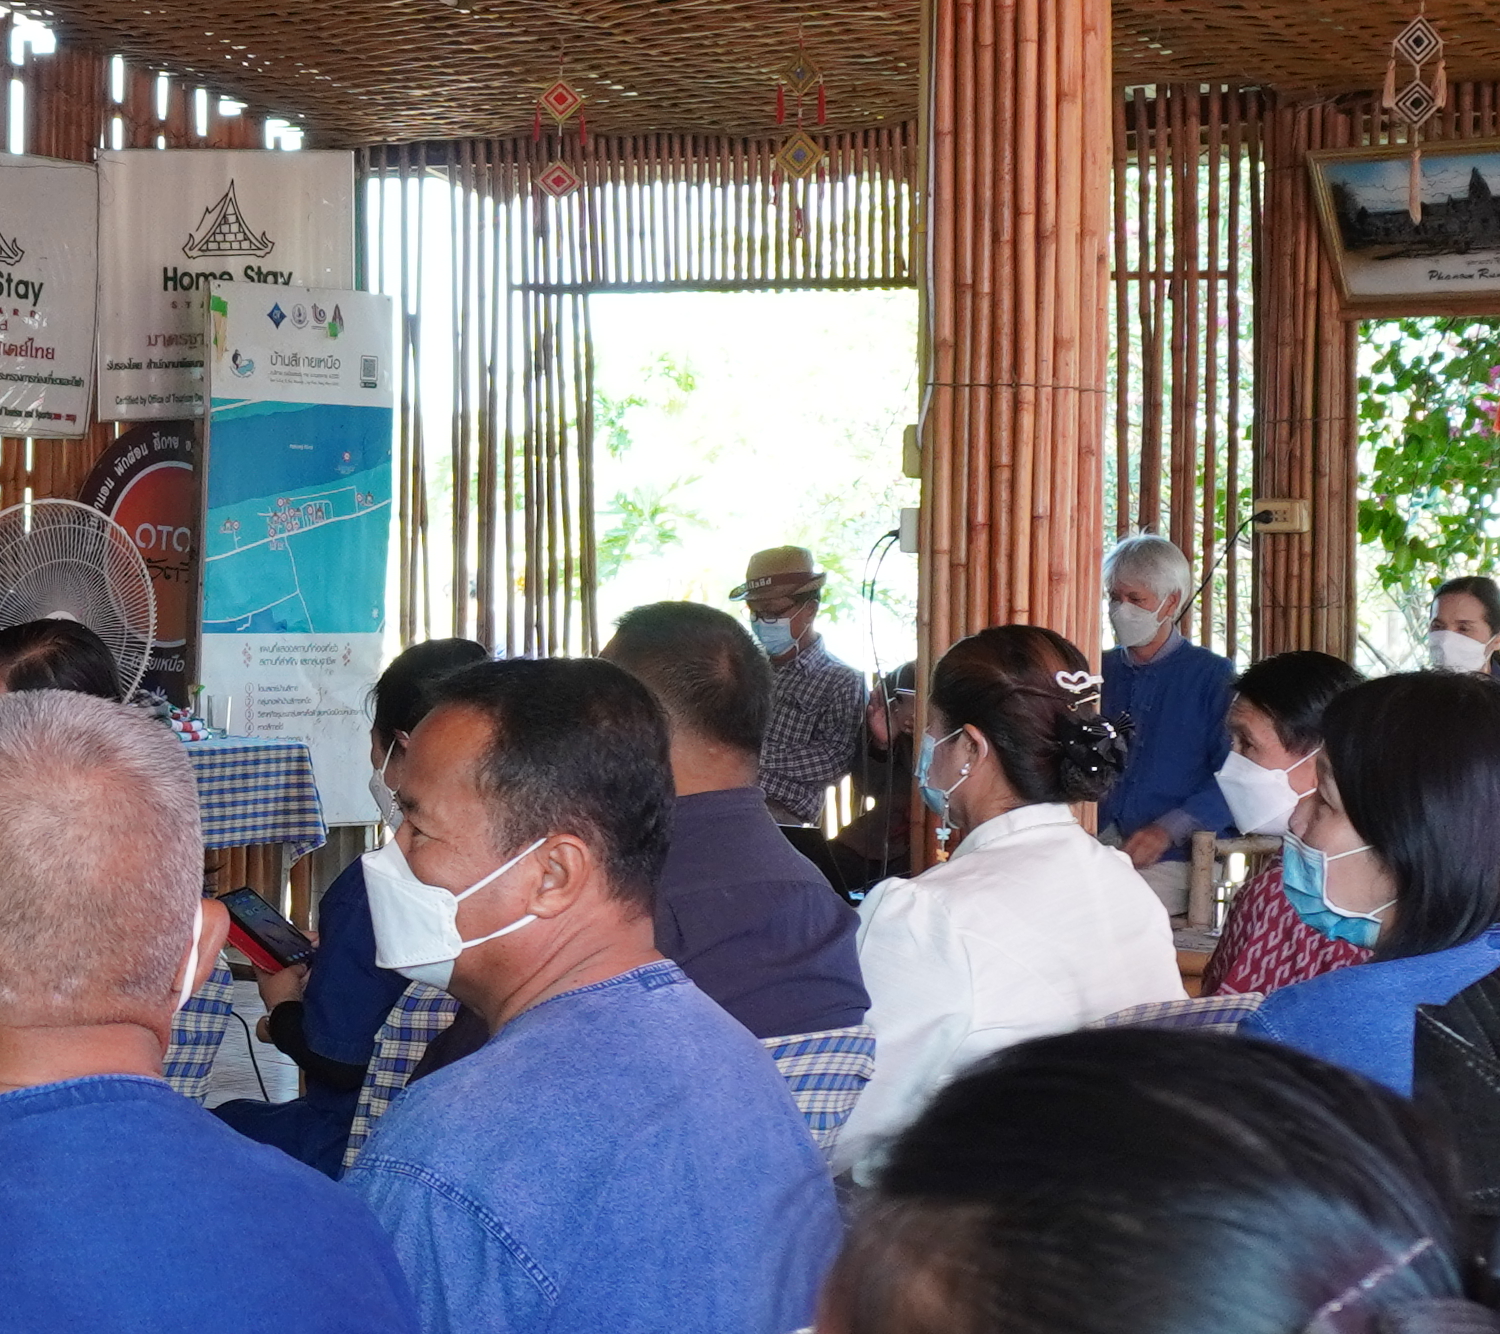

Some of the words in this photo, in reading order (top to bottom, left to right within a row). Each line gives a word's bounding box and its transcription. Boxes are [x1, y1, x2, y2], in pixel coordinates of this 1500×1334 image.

[270, 350, 341, 370] บ้านสีกายเหนือ
[135, 523, 192, 554] OTO
